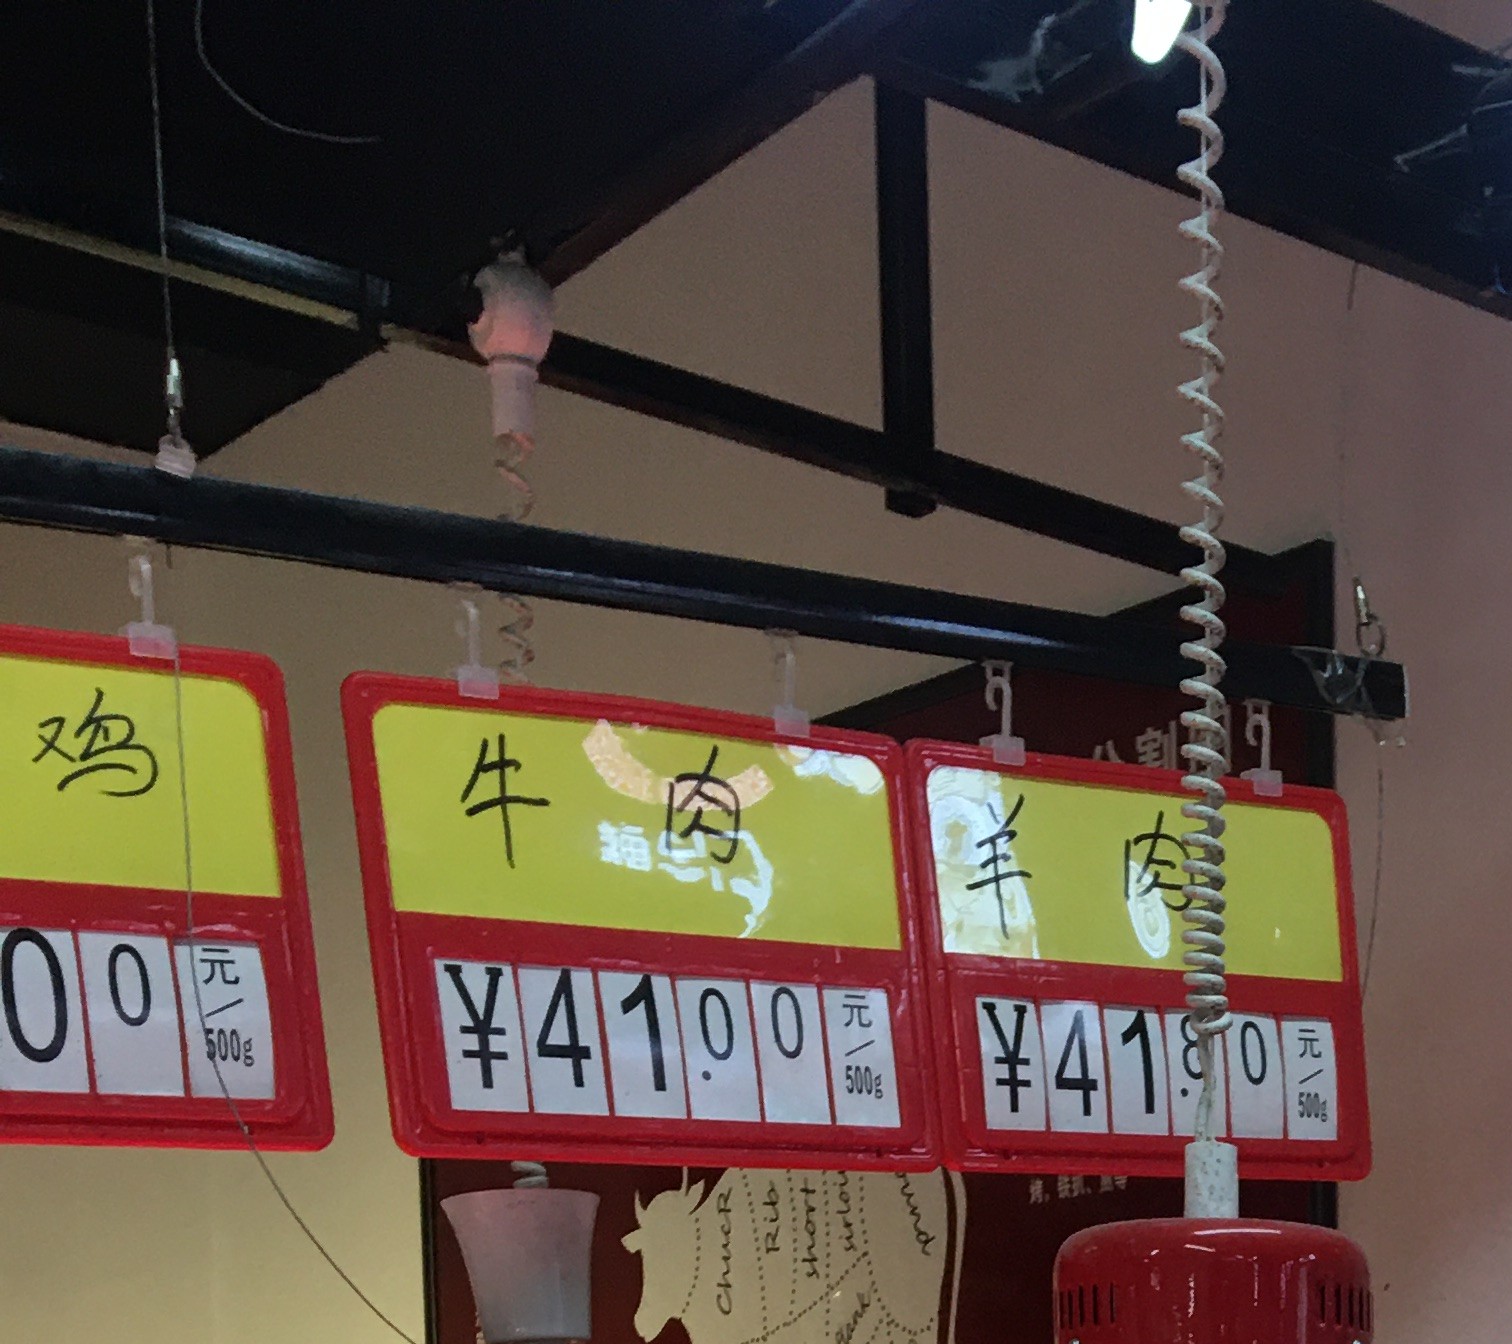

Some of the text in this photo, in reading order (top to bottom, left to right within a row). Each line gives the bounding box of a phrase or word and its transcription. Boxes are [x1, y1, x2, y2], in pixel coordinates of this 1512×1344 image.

[32, 690, 157, 797] 鸡
[462, 733, 742, 870] 牛肉
[966, 794, 1196, 939] 羊肉
[444, 963, 805, 1092] ¥41.00
[764, 1179, 781, 1254] Rib
[800, 1177, 820, 1280] short
[835, 1170, 857, 1253] sirloi
